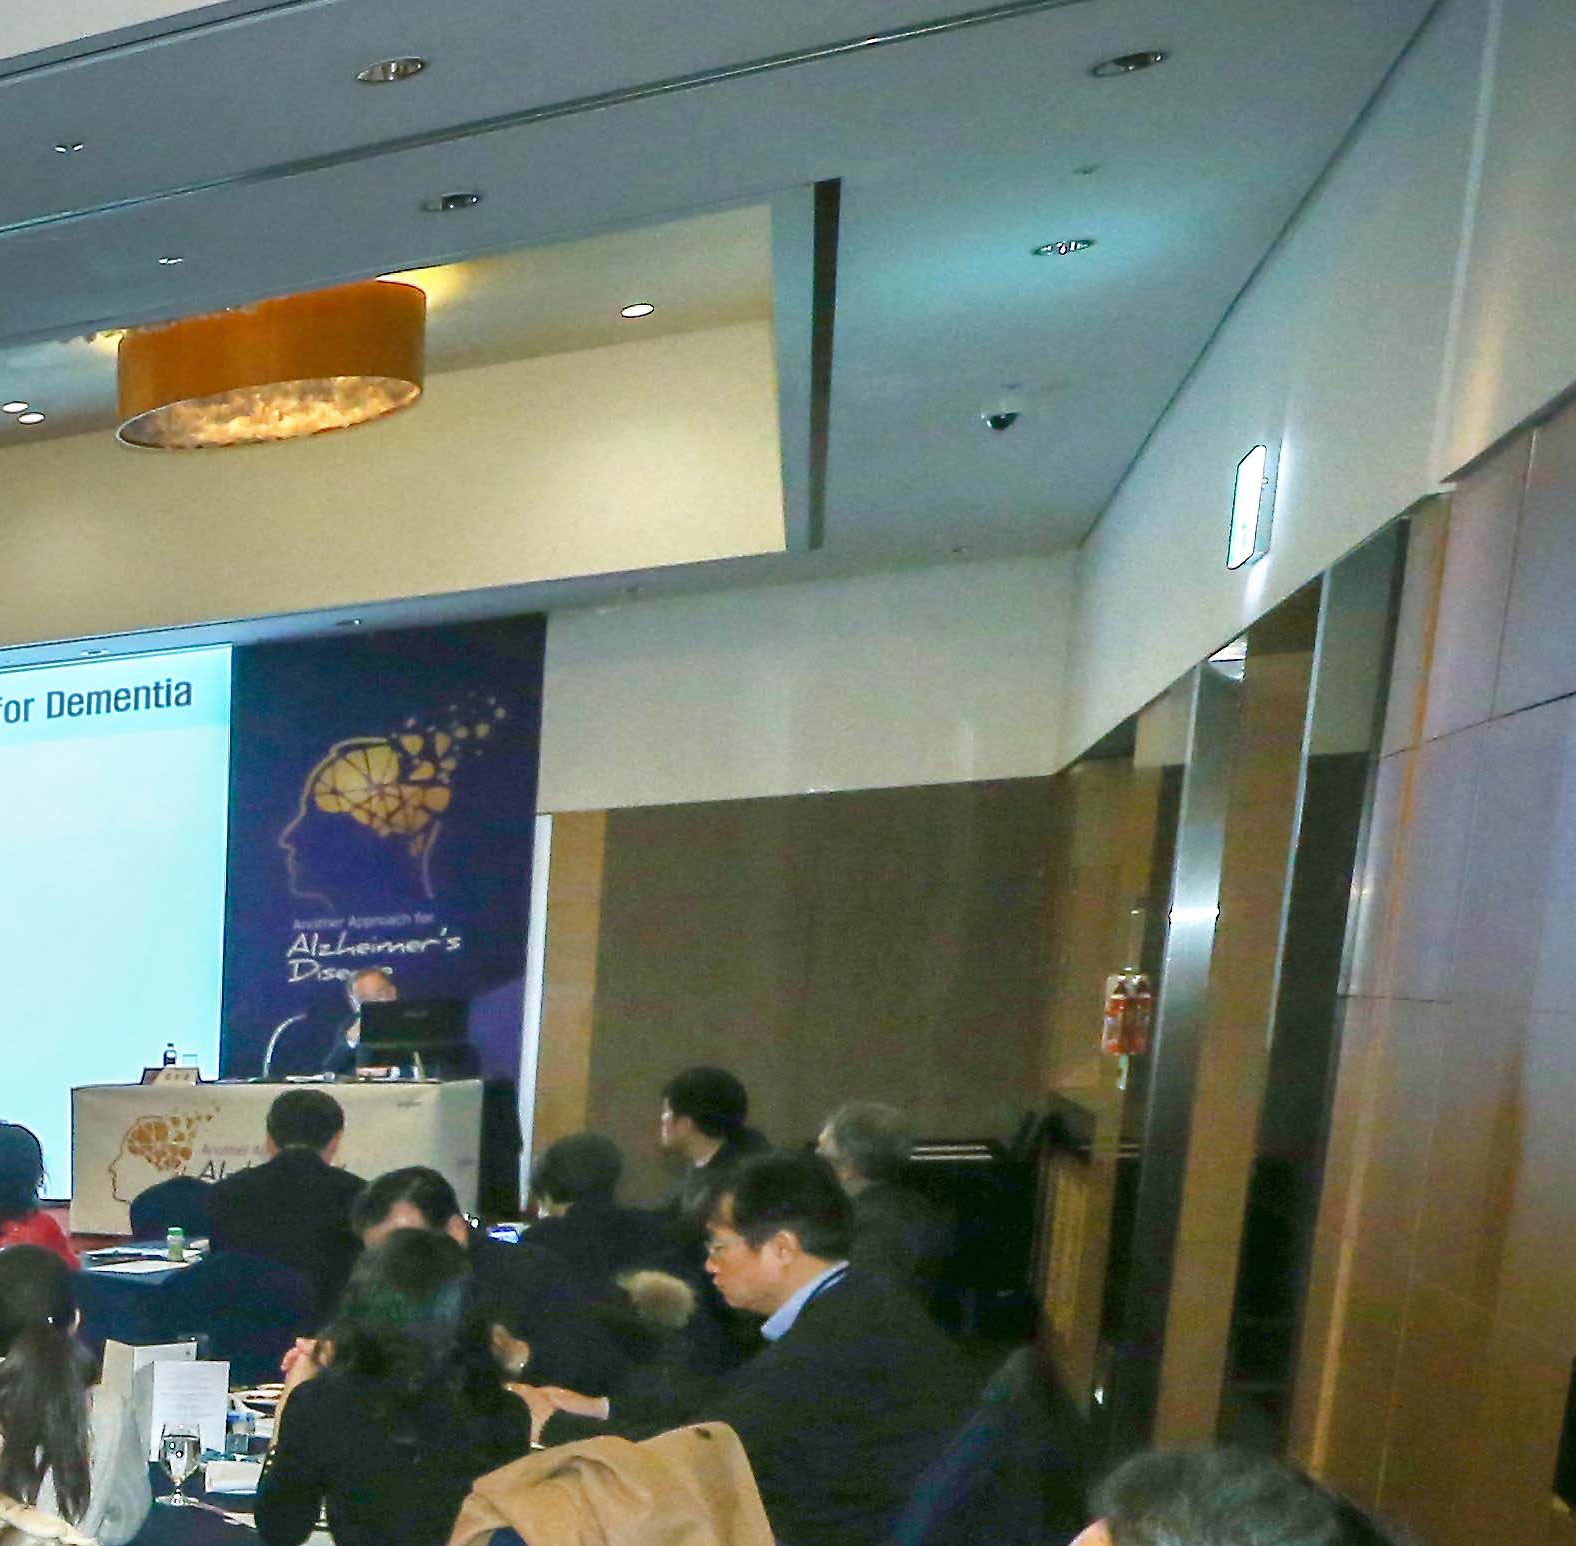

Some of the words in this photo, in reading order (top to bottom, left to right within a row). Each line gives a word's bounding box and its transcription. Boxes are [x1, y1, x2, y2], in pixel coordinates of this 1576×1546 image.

[47, 678, 193, 720] Dementia
[287, 927, 462, 958] Alzheimer's
[287, 959, 394, 983] Disee
